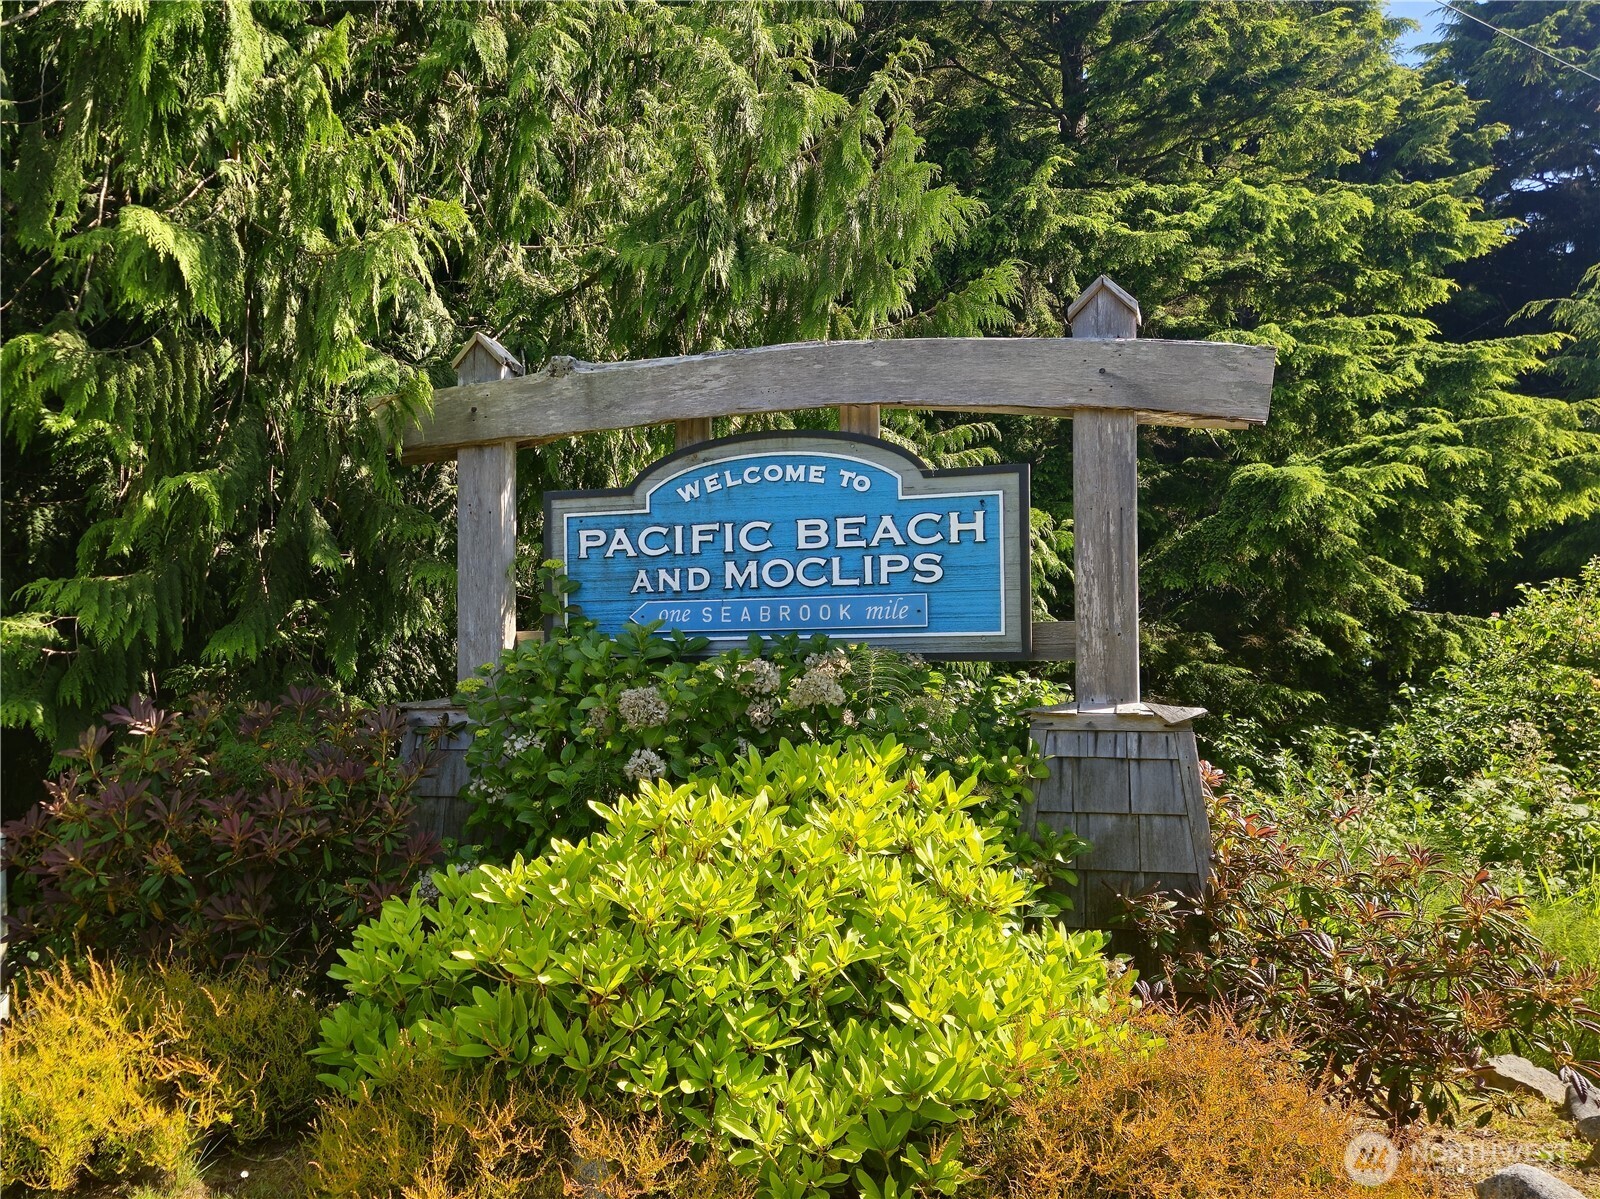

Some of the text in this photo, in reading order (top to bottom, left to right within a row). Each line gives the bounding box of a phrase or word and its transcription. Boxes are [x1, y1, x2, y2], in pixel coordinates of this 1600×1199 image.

[676, 464, 871, 503] WELCOME TO
[578, 510, 986, 559] PACIFIC BEACH
[630, 552, 944, 594] AND MOCLIPS
[659, 598, 909, 623] one SEABROOK mile
